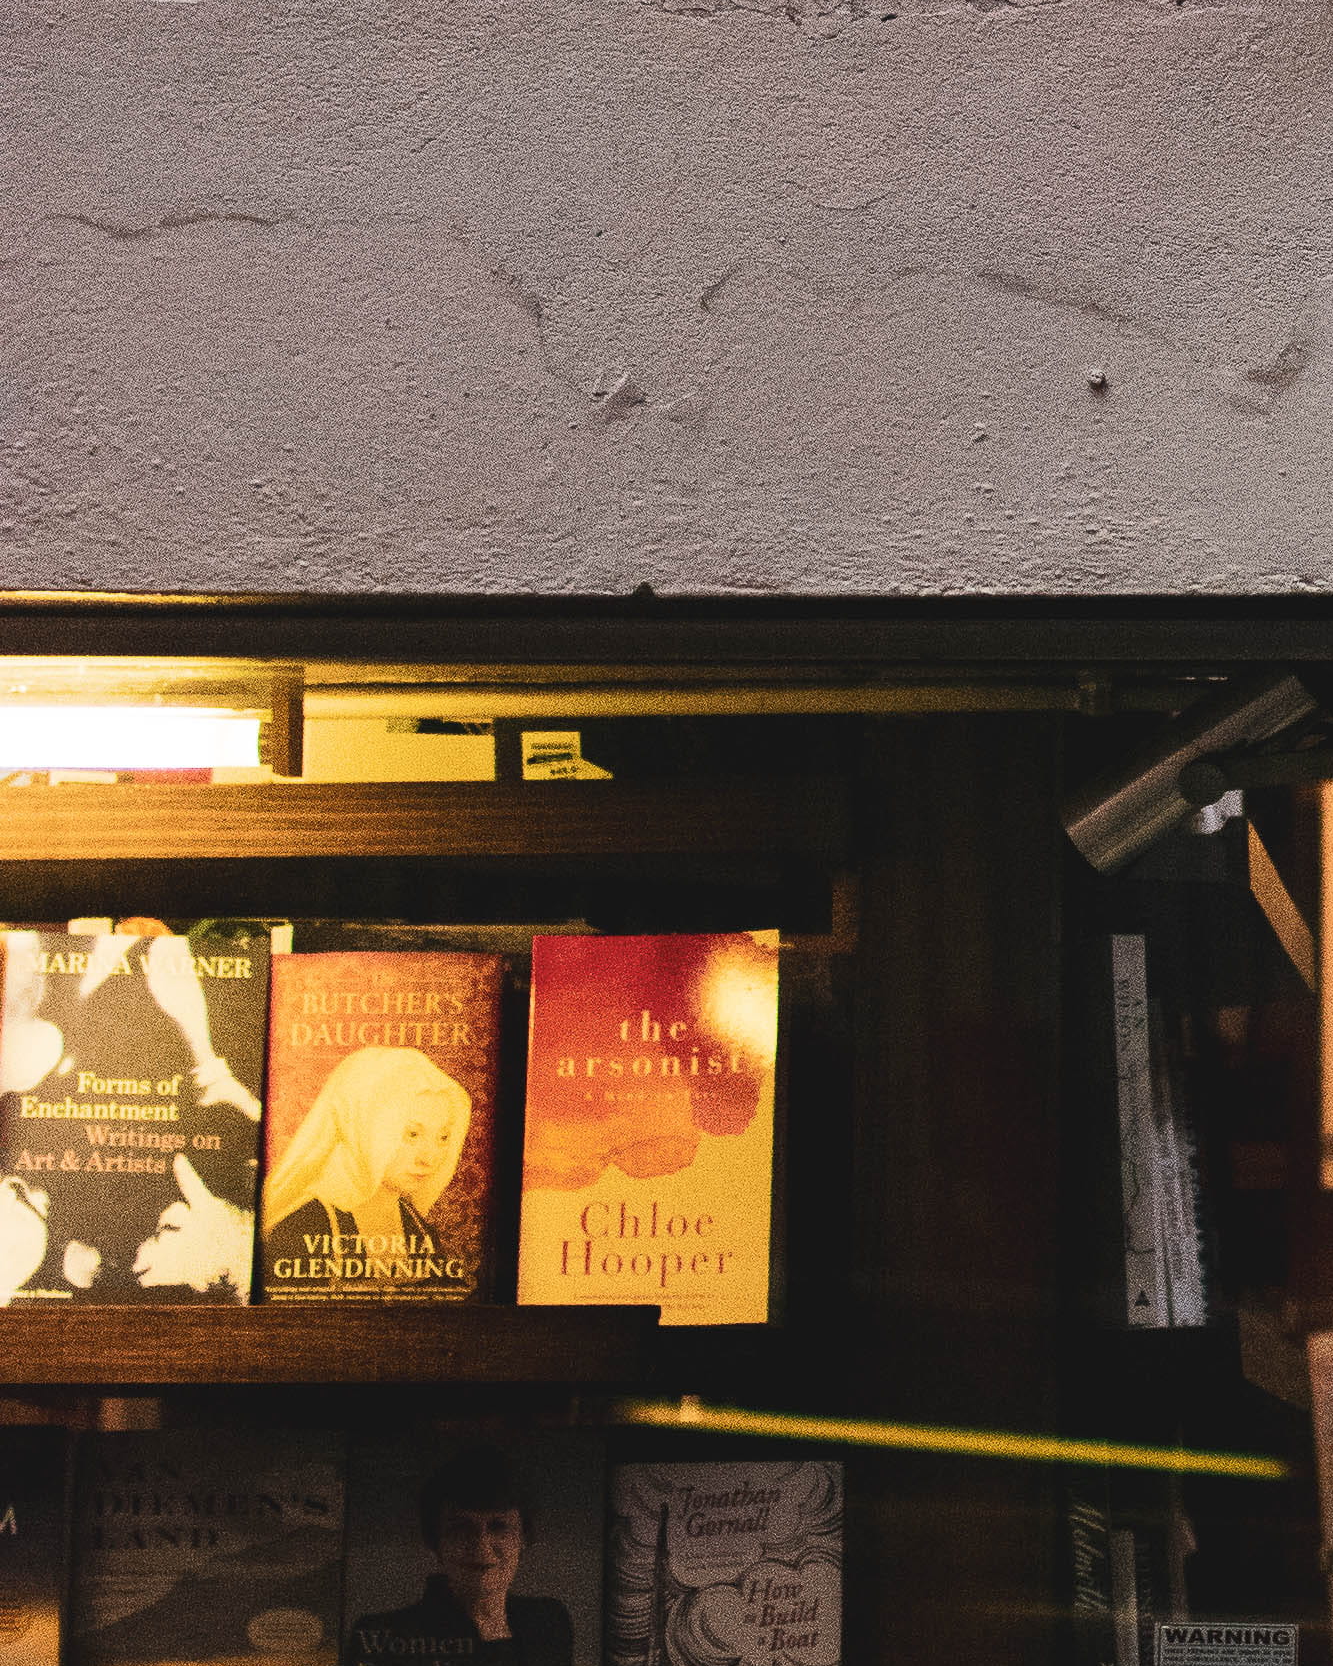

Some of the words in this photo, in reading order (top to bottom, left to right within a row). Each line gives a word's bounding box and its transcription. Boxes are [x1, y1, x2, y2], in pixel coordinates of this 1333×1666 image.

[302, 991, 465, 1016] BUTCHER'S
[290, 1021, 472, 1048] DAUGHTER
[618, 1009, 688, 1042] the
[556, 1046, 744, 1078] arsonist
[77, 1071, 151, 1095] Forms
[157, 1073, 183, 1096] of
[20, 1096, 179, 1121] Enchantment
[86, 1126, 186, 1152] Writings
[193, 1133, 221, 1151] on
[14, 1150, 54, 1171] Art
[60, 1150, 80, 1171] &
[86, 1151, 167, 1175] Artists
[580, 1201, 715, 1239] Chloe
[303, 1234, 436, 1255] VICTORIA
[273, 1257, 465, 1279] GLENDINNING
[559, 1239, 734, 1288] Hooper
[678, 1480, 782, 1519] Jonathan
[685, 1510, 770, 1539] Gornall
[93, 1527, 221, 1551] LAND
[748, 1577, 804, 1605] How
[759, 1599, 820, 1629] Build
[356, 1629, 475, 1656] Women
[770, 1630, 819, 1652] Boat
[1165, 1629, 1290, 1645] WARNING
